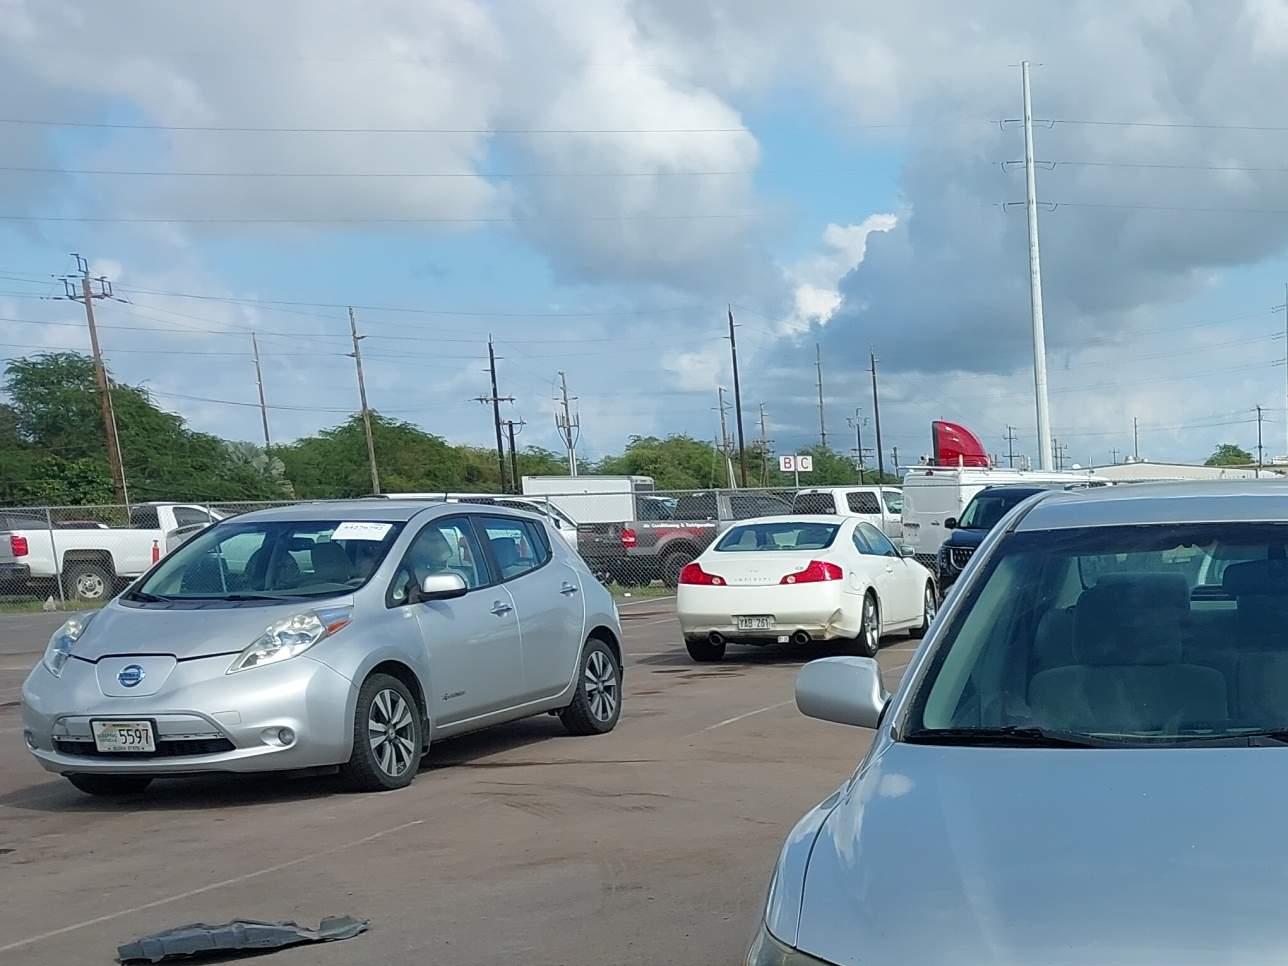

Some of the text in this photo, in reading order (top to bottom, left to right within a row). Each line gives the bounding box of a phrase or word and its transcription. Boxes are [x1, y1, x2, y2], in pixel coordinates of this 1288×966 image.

[784, 457, 792, 469] B
[801, 457, 809, 469] C
[118, 728, 149, 745] 5597
